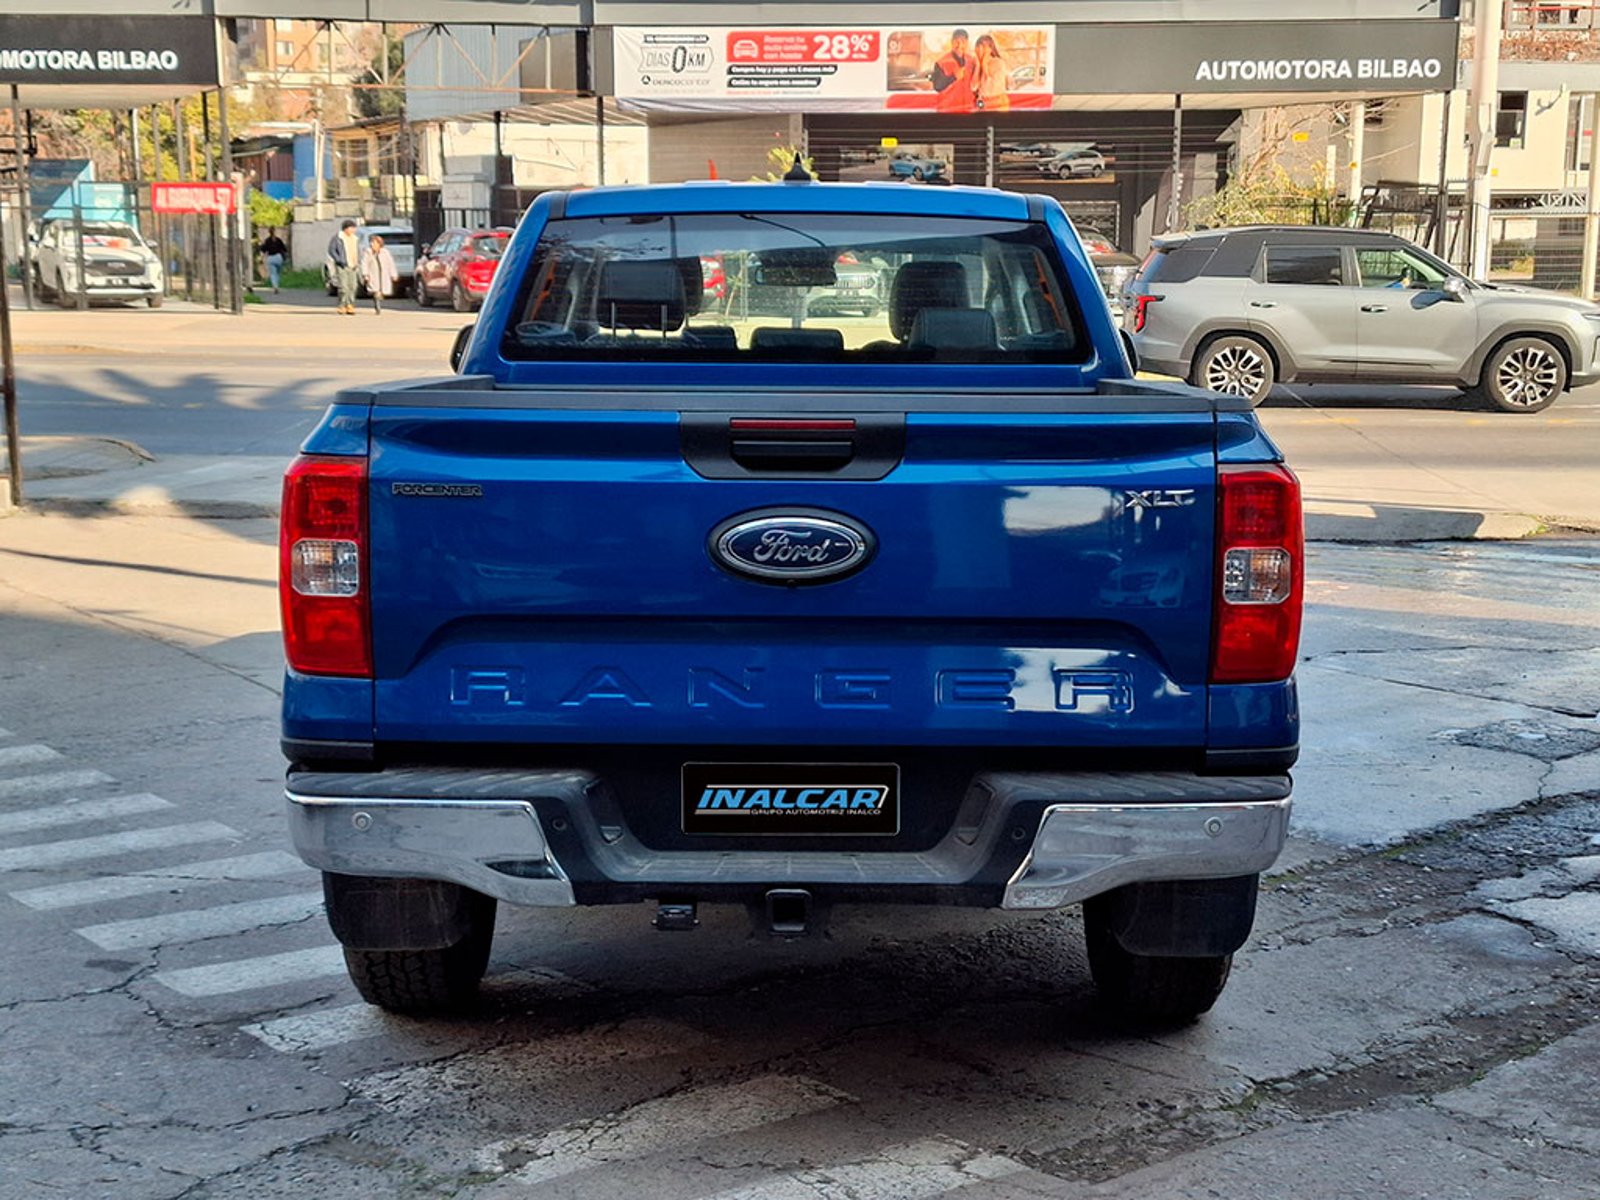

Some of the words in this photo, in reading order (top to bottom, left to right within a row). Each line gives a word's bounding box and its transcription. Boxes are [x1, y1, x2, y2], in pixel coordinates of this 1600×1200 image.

[0, 50, 96, 70] MOTORA
[98, 50, 178, 70] BILBAO
[1195, 60, 1352, 81] AUTOMOTORA
[1357, 59, 1442, 78] BILBAO
[1125, 488, 1194, 507] XLT
[754, 529, 832, 562] Ford
[450, 665, 1135, 713] RANGER
[697, 788, 880, 808] INALCAR
